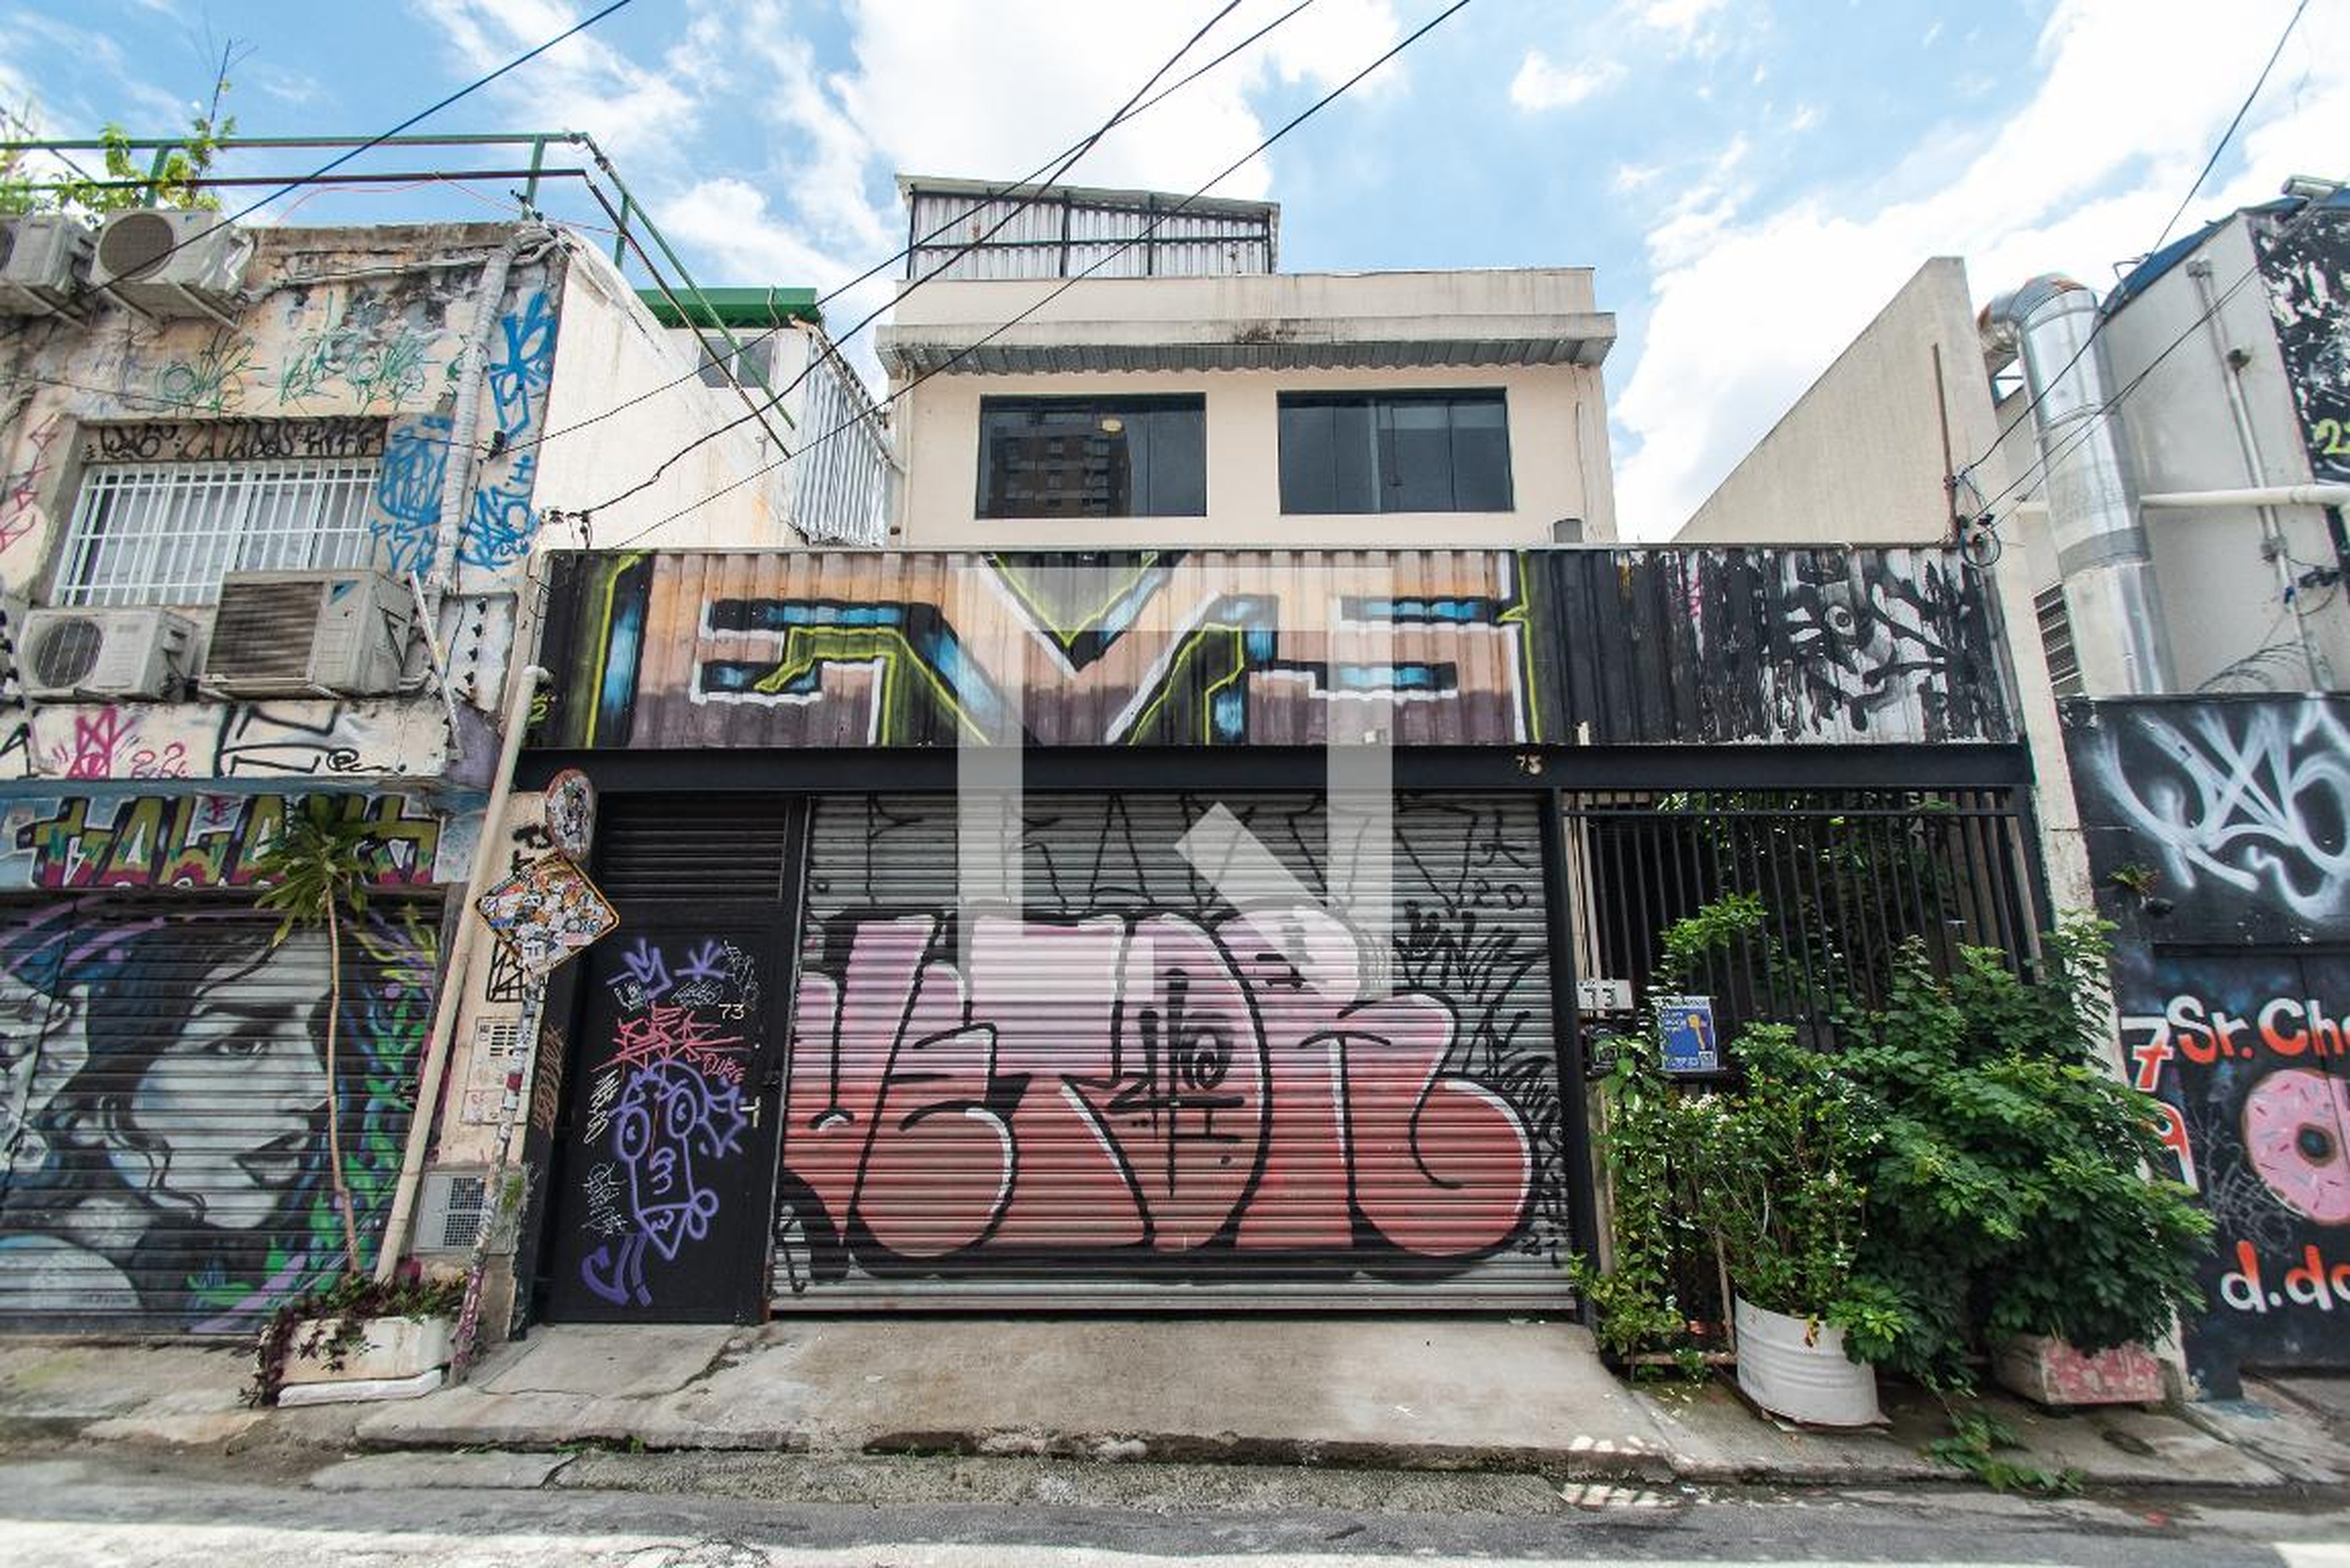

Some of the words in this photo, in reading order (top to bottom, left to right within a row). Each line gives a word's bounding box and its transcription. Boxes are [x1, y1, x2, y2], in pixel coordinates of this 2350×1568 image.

[718, 1003, 745, 1020] 73
[2166, 995, 2255, 1064] Sr.
[2258, 998, 2350, 1056] Ch
